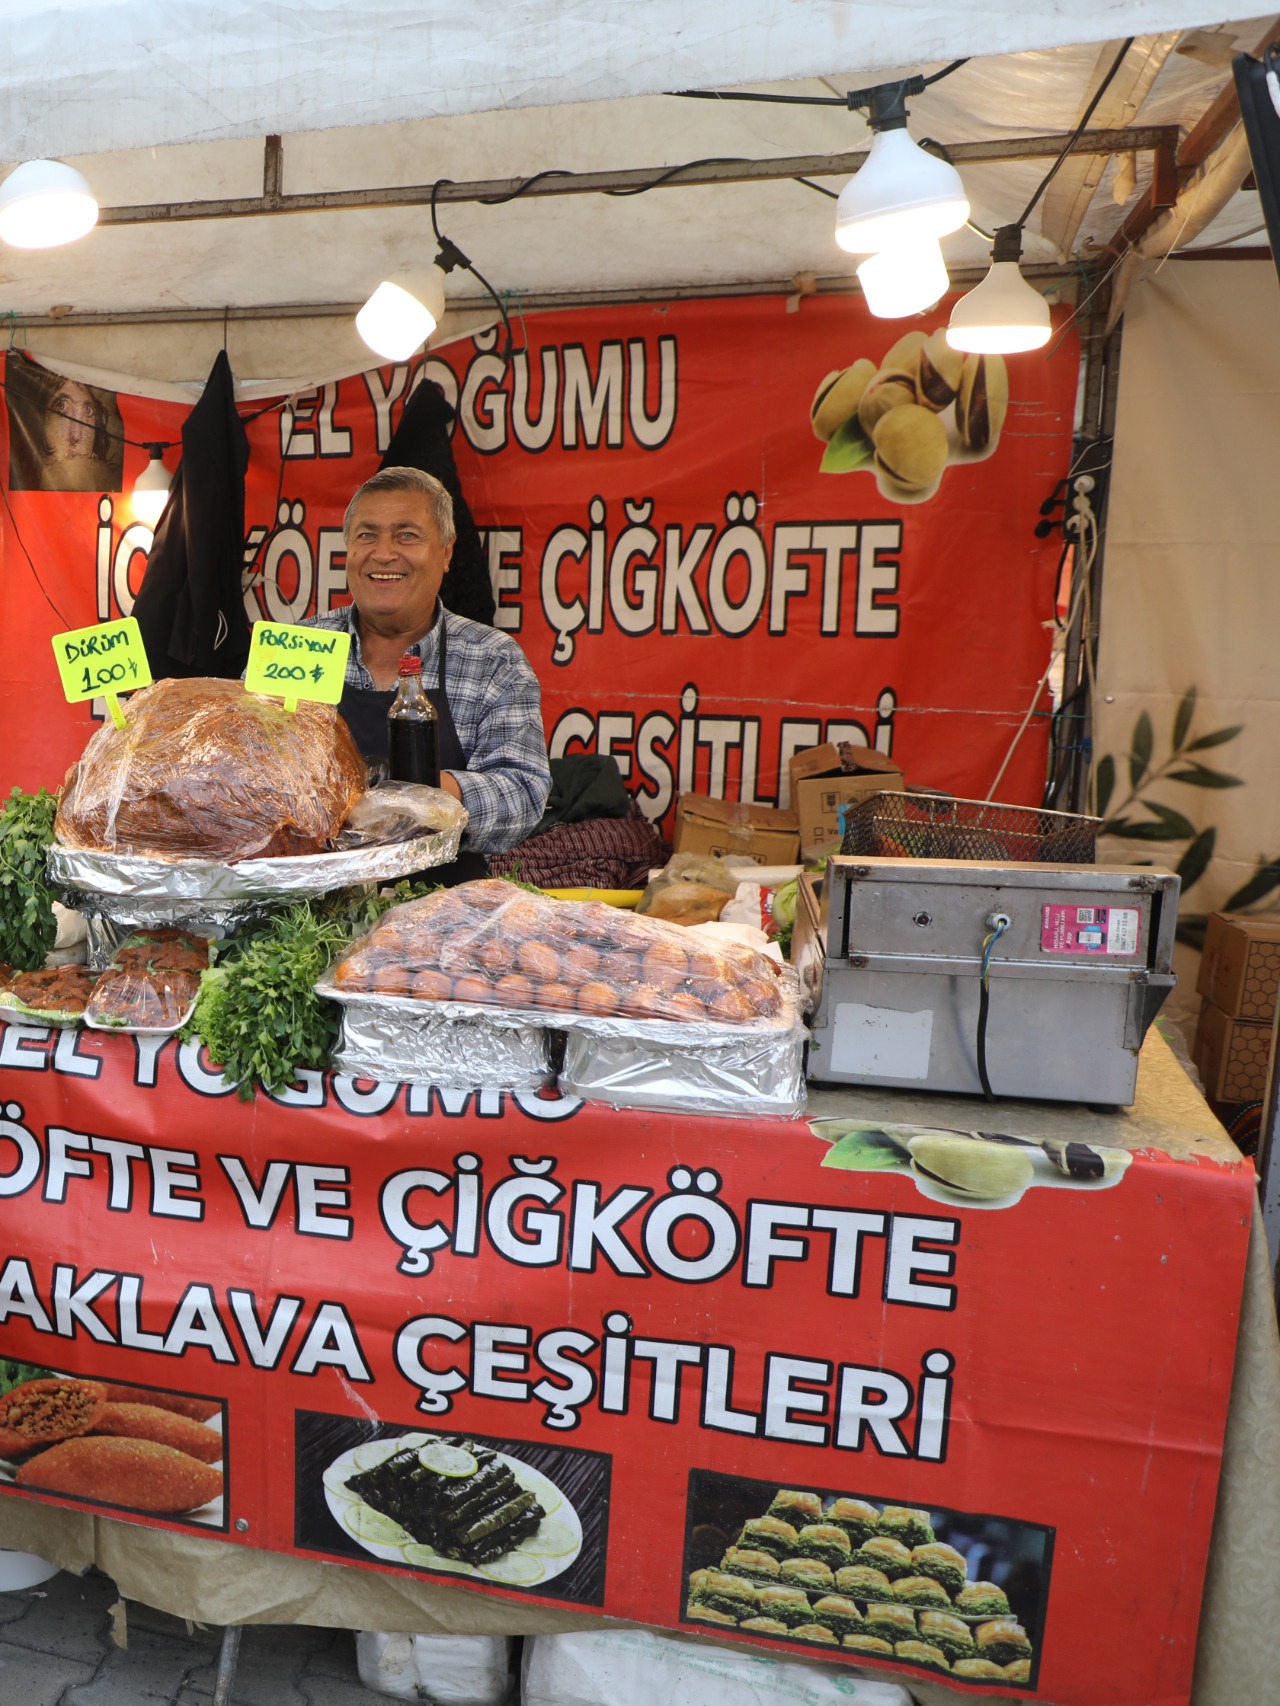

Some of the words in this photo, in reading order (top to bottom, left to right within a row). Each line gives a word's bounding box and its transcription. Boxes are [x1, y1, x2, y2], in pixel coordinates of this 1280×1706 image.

[281, 381, 353, 458] EL
[540, 491, 903, 666] ÇİĞKÖFTE
[219, 1153, 354, 1242] VE
[379, 1151, 962, 1311] ÇİĞKÖFTE
[395, 1310, 955, 1463] ÇEŞİTLERİ
